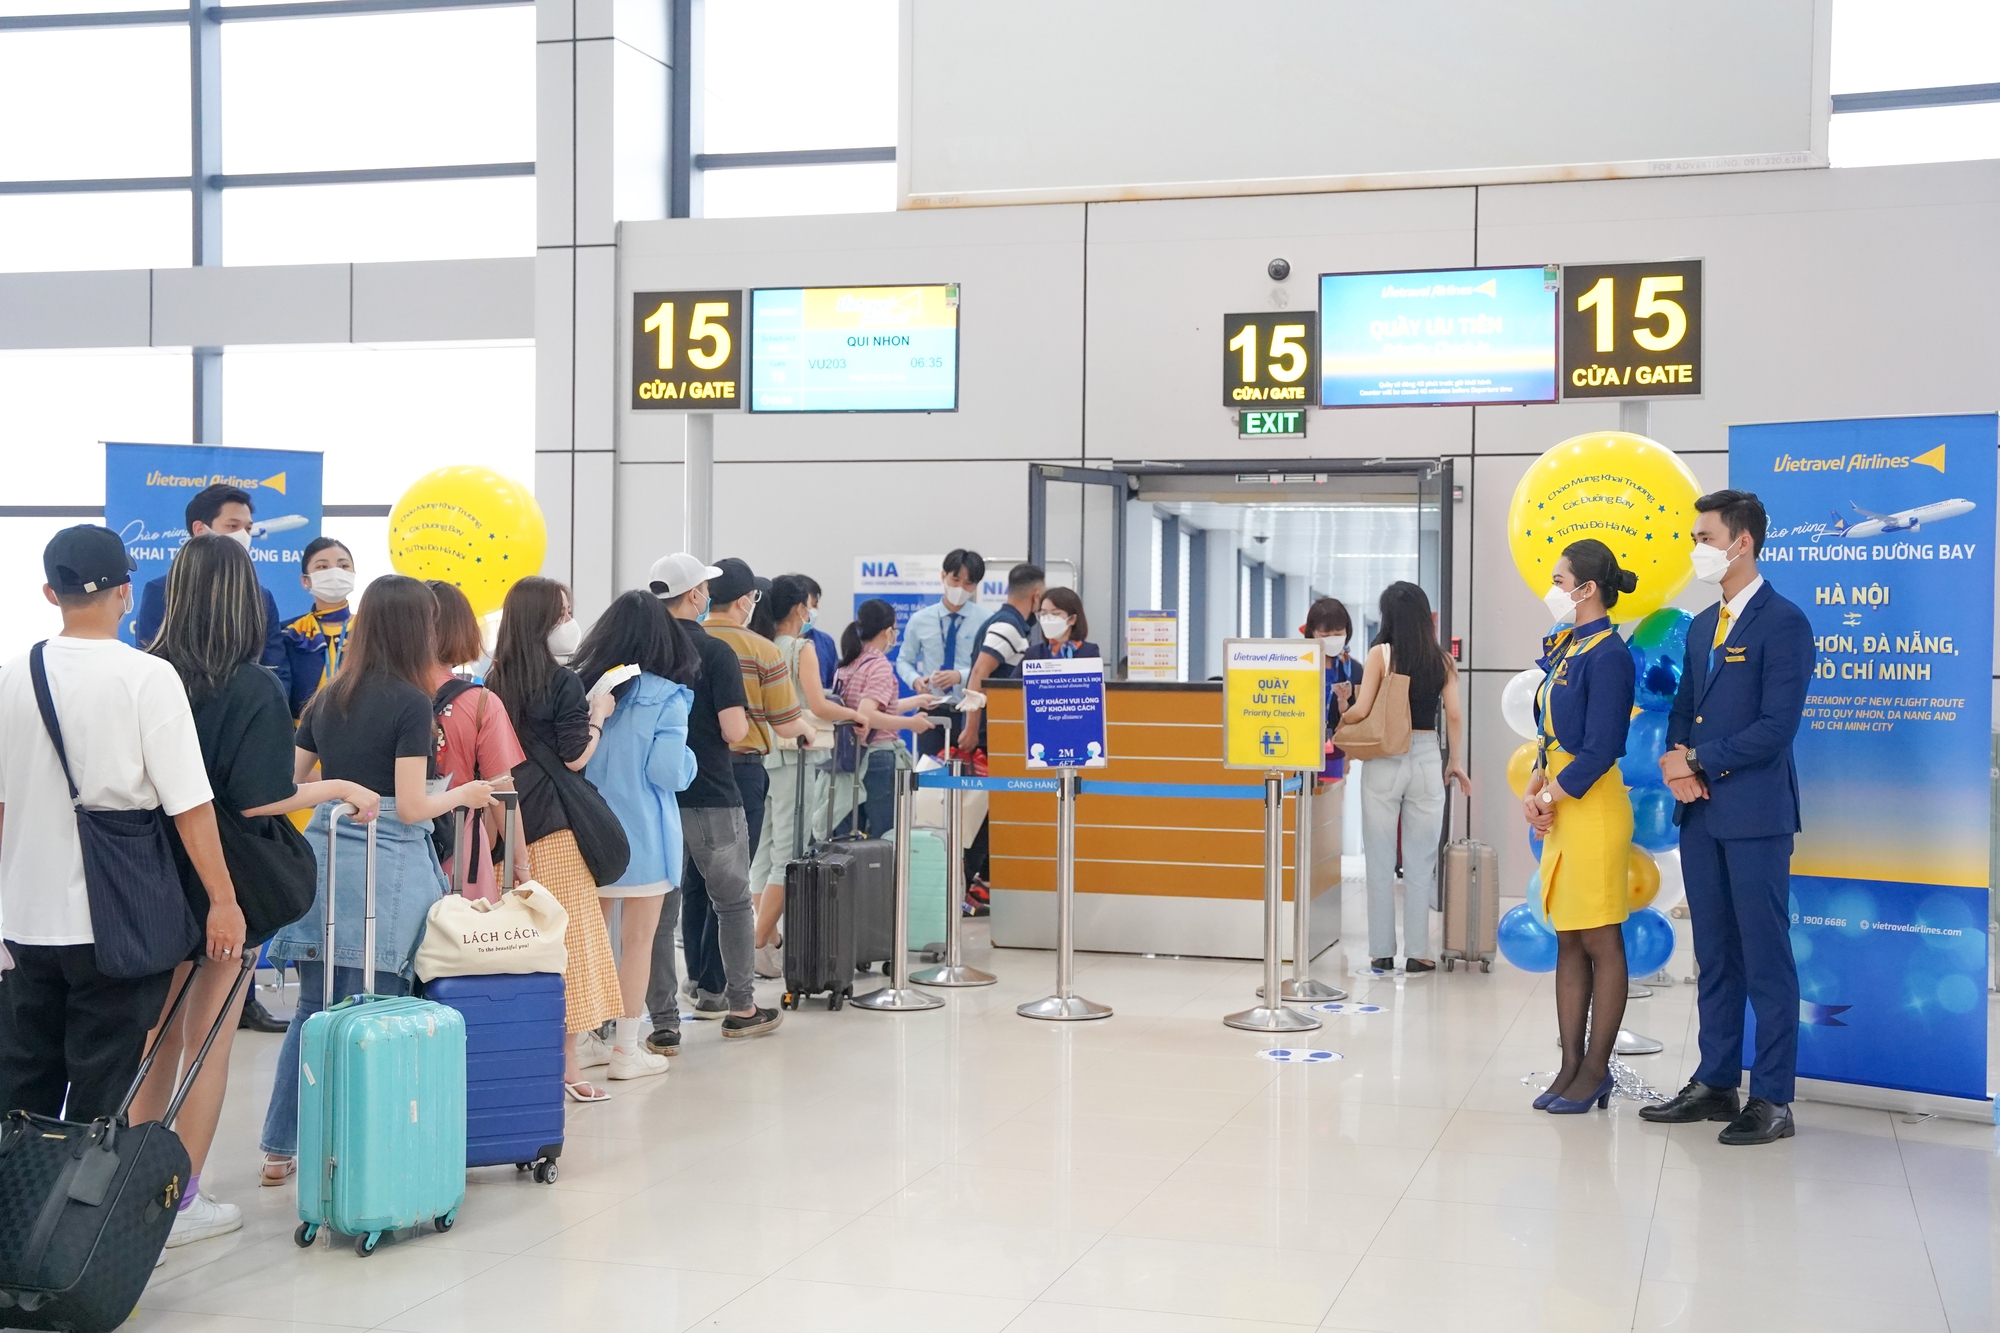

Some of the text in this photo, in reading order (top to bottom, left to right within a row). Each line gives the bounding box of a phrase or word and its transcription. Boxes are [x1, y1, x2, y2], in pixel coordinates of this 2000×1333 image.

[1653, 163, 1672, 172] FOR
[1743, 156, 1809, 167] 091.320.6288
[1577, 275, 1687, 352] 15
[644, 302, 732, 370] 15
[846, 335, 910, 347] QUI NHON
[1229, 324, 1308, 383] 15
[808, 357, 943, 370] VU203 06:35
[1572, 364, 1693, 386] CỬA / GATE
[639, 379, 735, 399] CỬA / GATE
[1232, 386, 1262, 400] CỬA
[1270, 387, 1305, 400] GATE
[1246, 412, 1299, 433] EXIT
[1774, 453, 1910, 472] Vietravel Airlines
[146, 470, 258, 489] Vietravel Airlines
[1601, 473, 1624, 483] Khai
[1615, 496, 1635, 510] Bay
[129, 547, 164, 560] KHAI
[250, 546, 279, 562] ỜNG
[1797, 544, 1867, 561] TRƯƠNG
[1872, 541, 1933, 561] ĐƯỜNG
[1939, 544, 1976, 560] BAY
[861, 561, 899, 578] NIA
[1815, 582, 1890, 610] HÀ NỘI
[1813, 630, 1959, 656] HƠN, ĐÀ NẴNG,
[1233, 652, 1298, 662] Vietravel Airlines
[1025, 662, 1042, 670] NIA
[1841, 659, 1875, 680] CHÍ
[1878, 663, 1932, 681] MINH
[1258, 676, 1289, 691] QUẦY
[1252, 692, 1295, 704] ƯU TIÊN
[1804, 695, 1966, 709] EREMONY OF NEW FLIGHT ROUTE
[1243, 708, 1305, 719] Priority Check-in
[1818, 708, 1831, 717] TO
[1832, 708, 1854, 718] QUY
[1855, 709, 1885, 720] NHON,
[1887, 710, 1901, 719] DA
[1903, 710, 1931, 720] NANG
[1933, 711, 1957, 721] AND
[1811, 720, 1894, 732] HO CHI MINH CITY
[1058, 748, 1074, 758] 2M
[961, 778, 984, 788] N.I.A
[1803, 916, 1962, 937] 1900 6686 vietravelairlines.com
[463, 927, 540, 944] LÁCH CÁCH
[495, 944, 518, 952] beautiful
